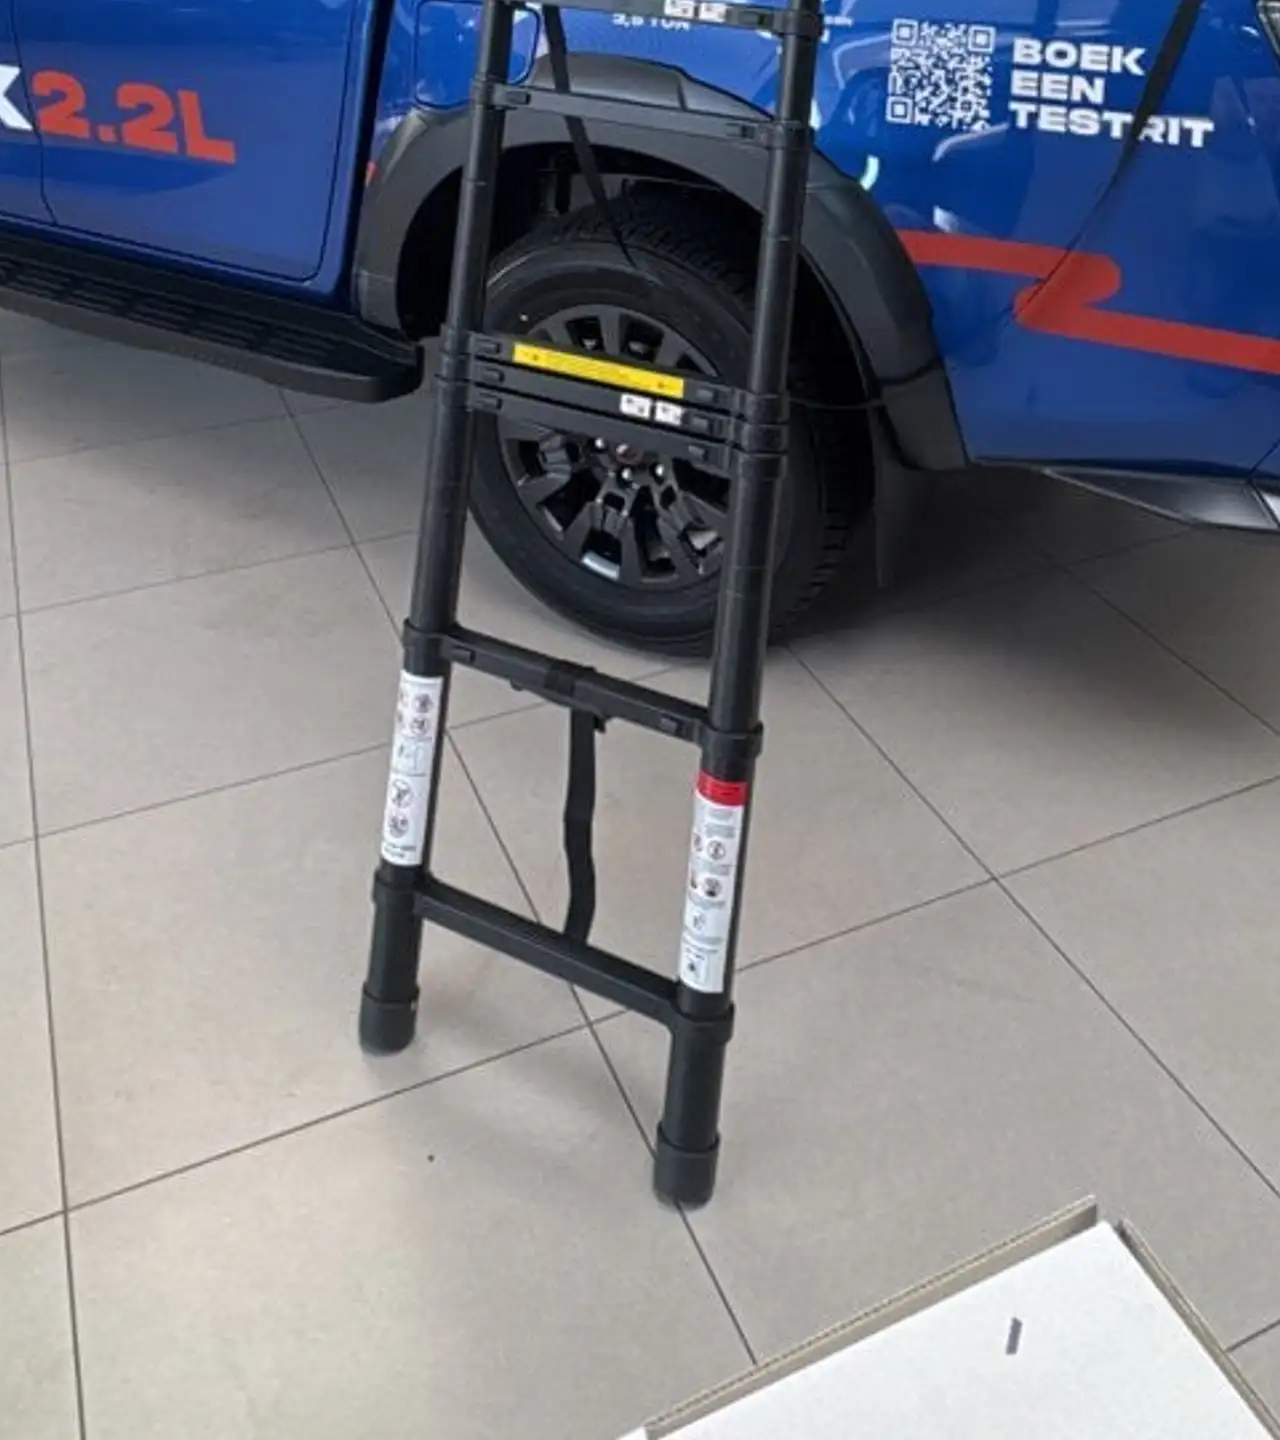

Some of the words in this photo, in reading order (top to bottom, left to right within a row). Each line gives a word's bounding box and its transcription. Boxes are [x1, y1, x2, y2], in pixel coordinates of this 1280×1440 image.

[1012, 36, 1147, 77] BOEK
[1010, 68, 1106, 105] EEN
[31, 69, 237, 165] 2.2L
[1008, 100, 1215, 148] TESTRIT
